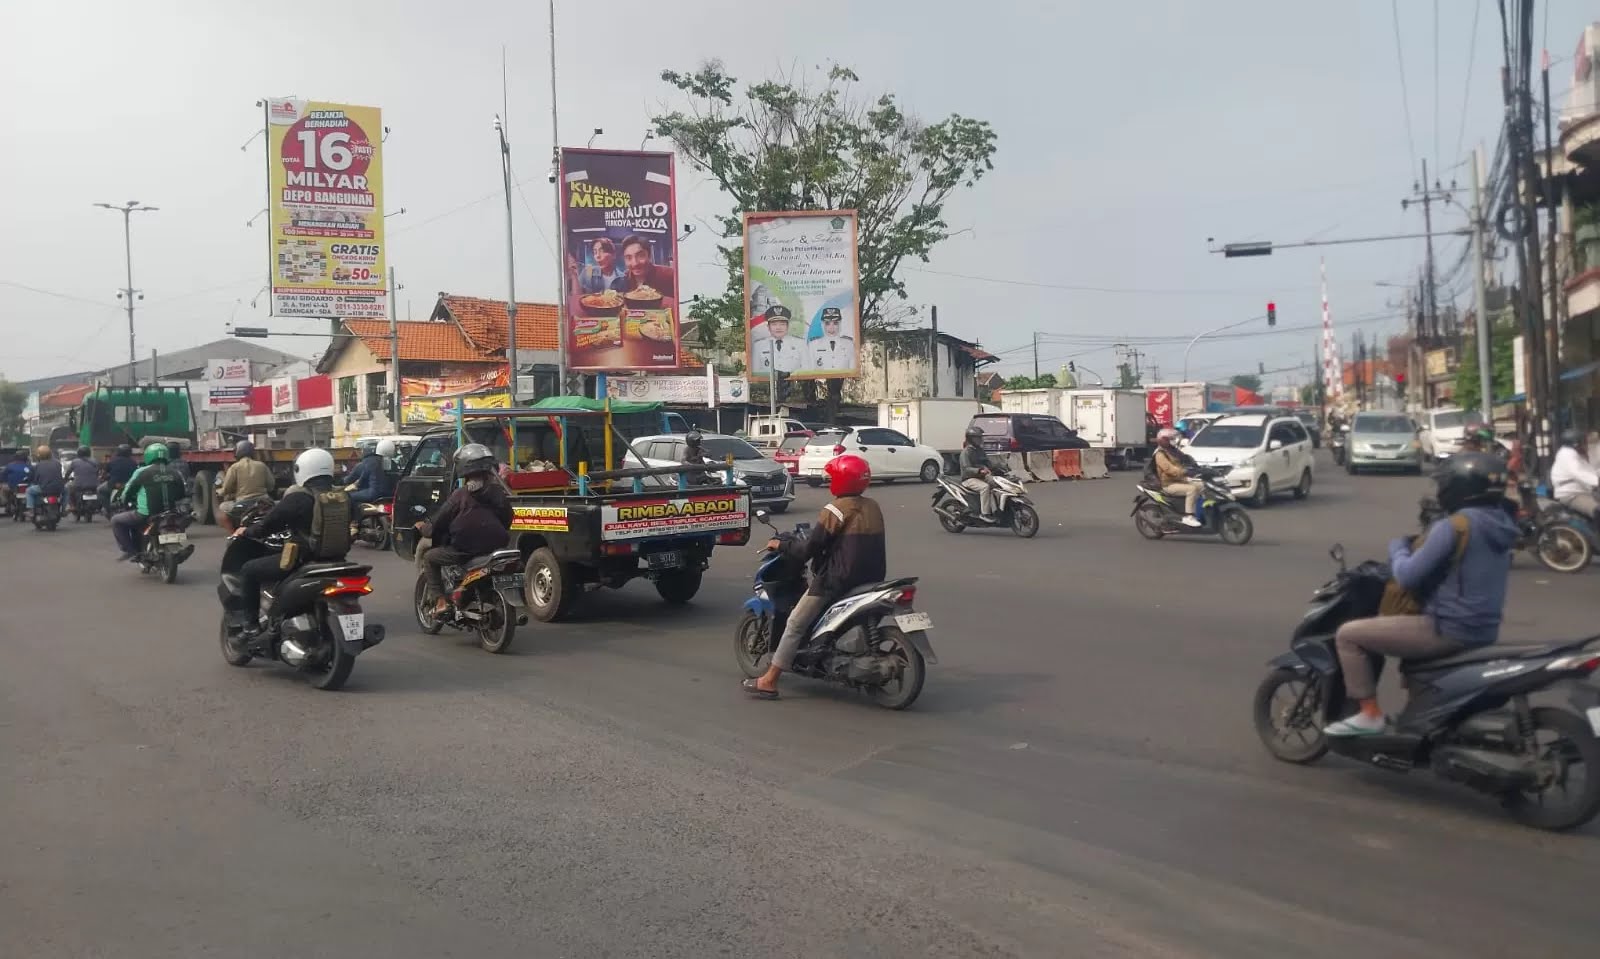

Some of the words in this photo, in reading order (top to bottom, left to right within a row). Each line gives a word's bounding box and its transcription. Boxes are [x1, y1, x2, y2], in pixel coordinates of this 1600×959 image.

[310, 111, 344, 119] BELANJA
[304, 120, 348, 128] BERHADIAH
[297, 130, 353, 170] 16
[287, 171, 367, 190] MILYAR
[283, 190, 312, 201] DEPO
[314, 192, 373, 206] BANGUNAN
[570, 181, 609, 196] KUAH
[611, 190, 631, 199] KOYA
[570, 192, 631, 208] MEDOK
[604, 208, 625, 220] BIKIN
[626, 202, 668, 218] AUTO
[800, 235, 809, 245] &
[330, 244, 380, 256] GRATIS
[351, 268, 370, 280] 50
[536, 509, 566, 518] ABADI
[619, 504, 679, 520] RIMBA
[681, 500, 735, 514] ABADI
